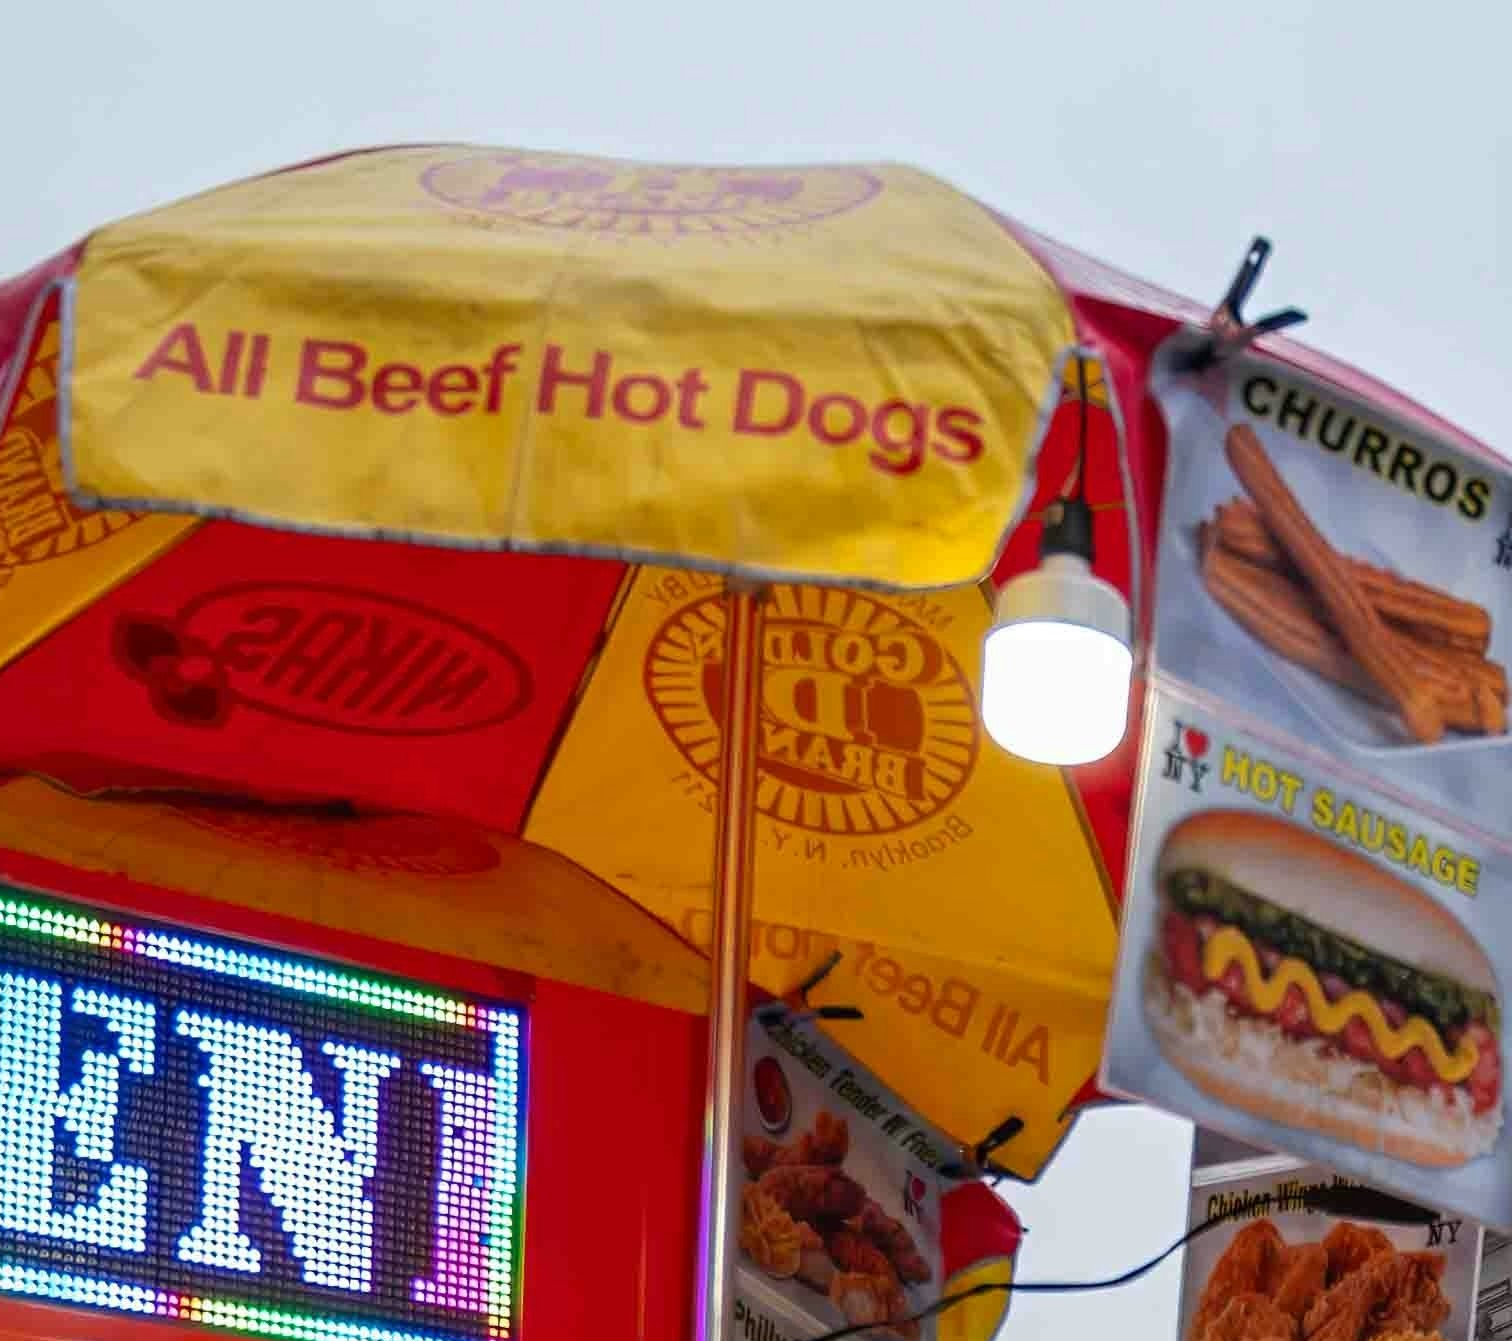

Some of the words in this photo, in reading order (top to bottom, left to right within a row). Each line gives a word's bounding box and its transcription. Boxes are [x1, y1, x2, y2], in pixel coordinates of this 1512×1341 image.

[134, 322, 271, 400] All
[296, 340, 523, 415] Beef
[535, 345, 706, 430] Hot
[731, 368, 986, 477] Dogs
[1240, 374, 1493, 523] CHURROS
[1162, 749, 1210, 793] NY
[1222, 745, 1303, 813] HOT
[1311, 785, 1481, 896] SAUSAGE
[1427, 1220, 1462, 1247] NY
